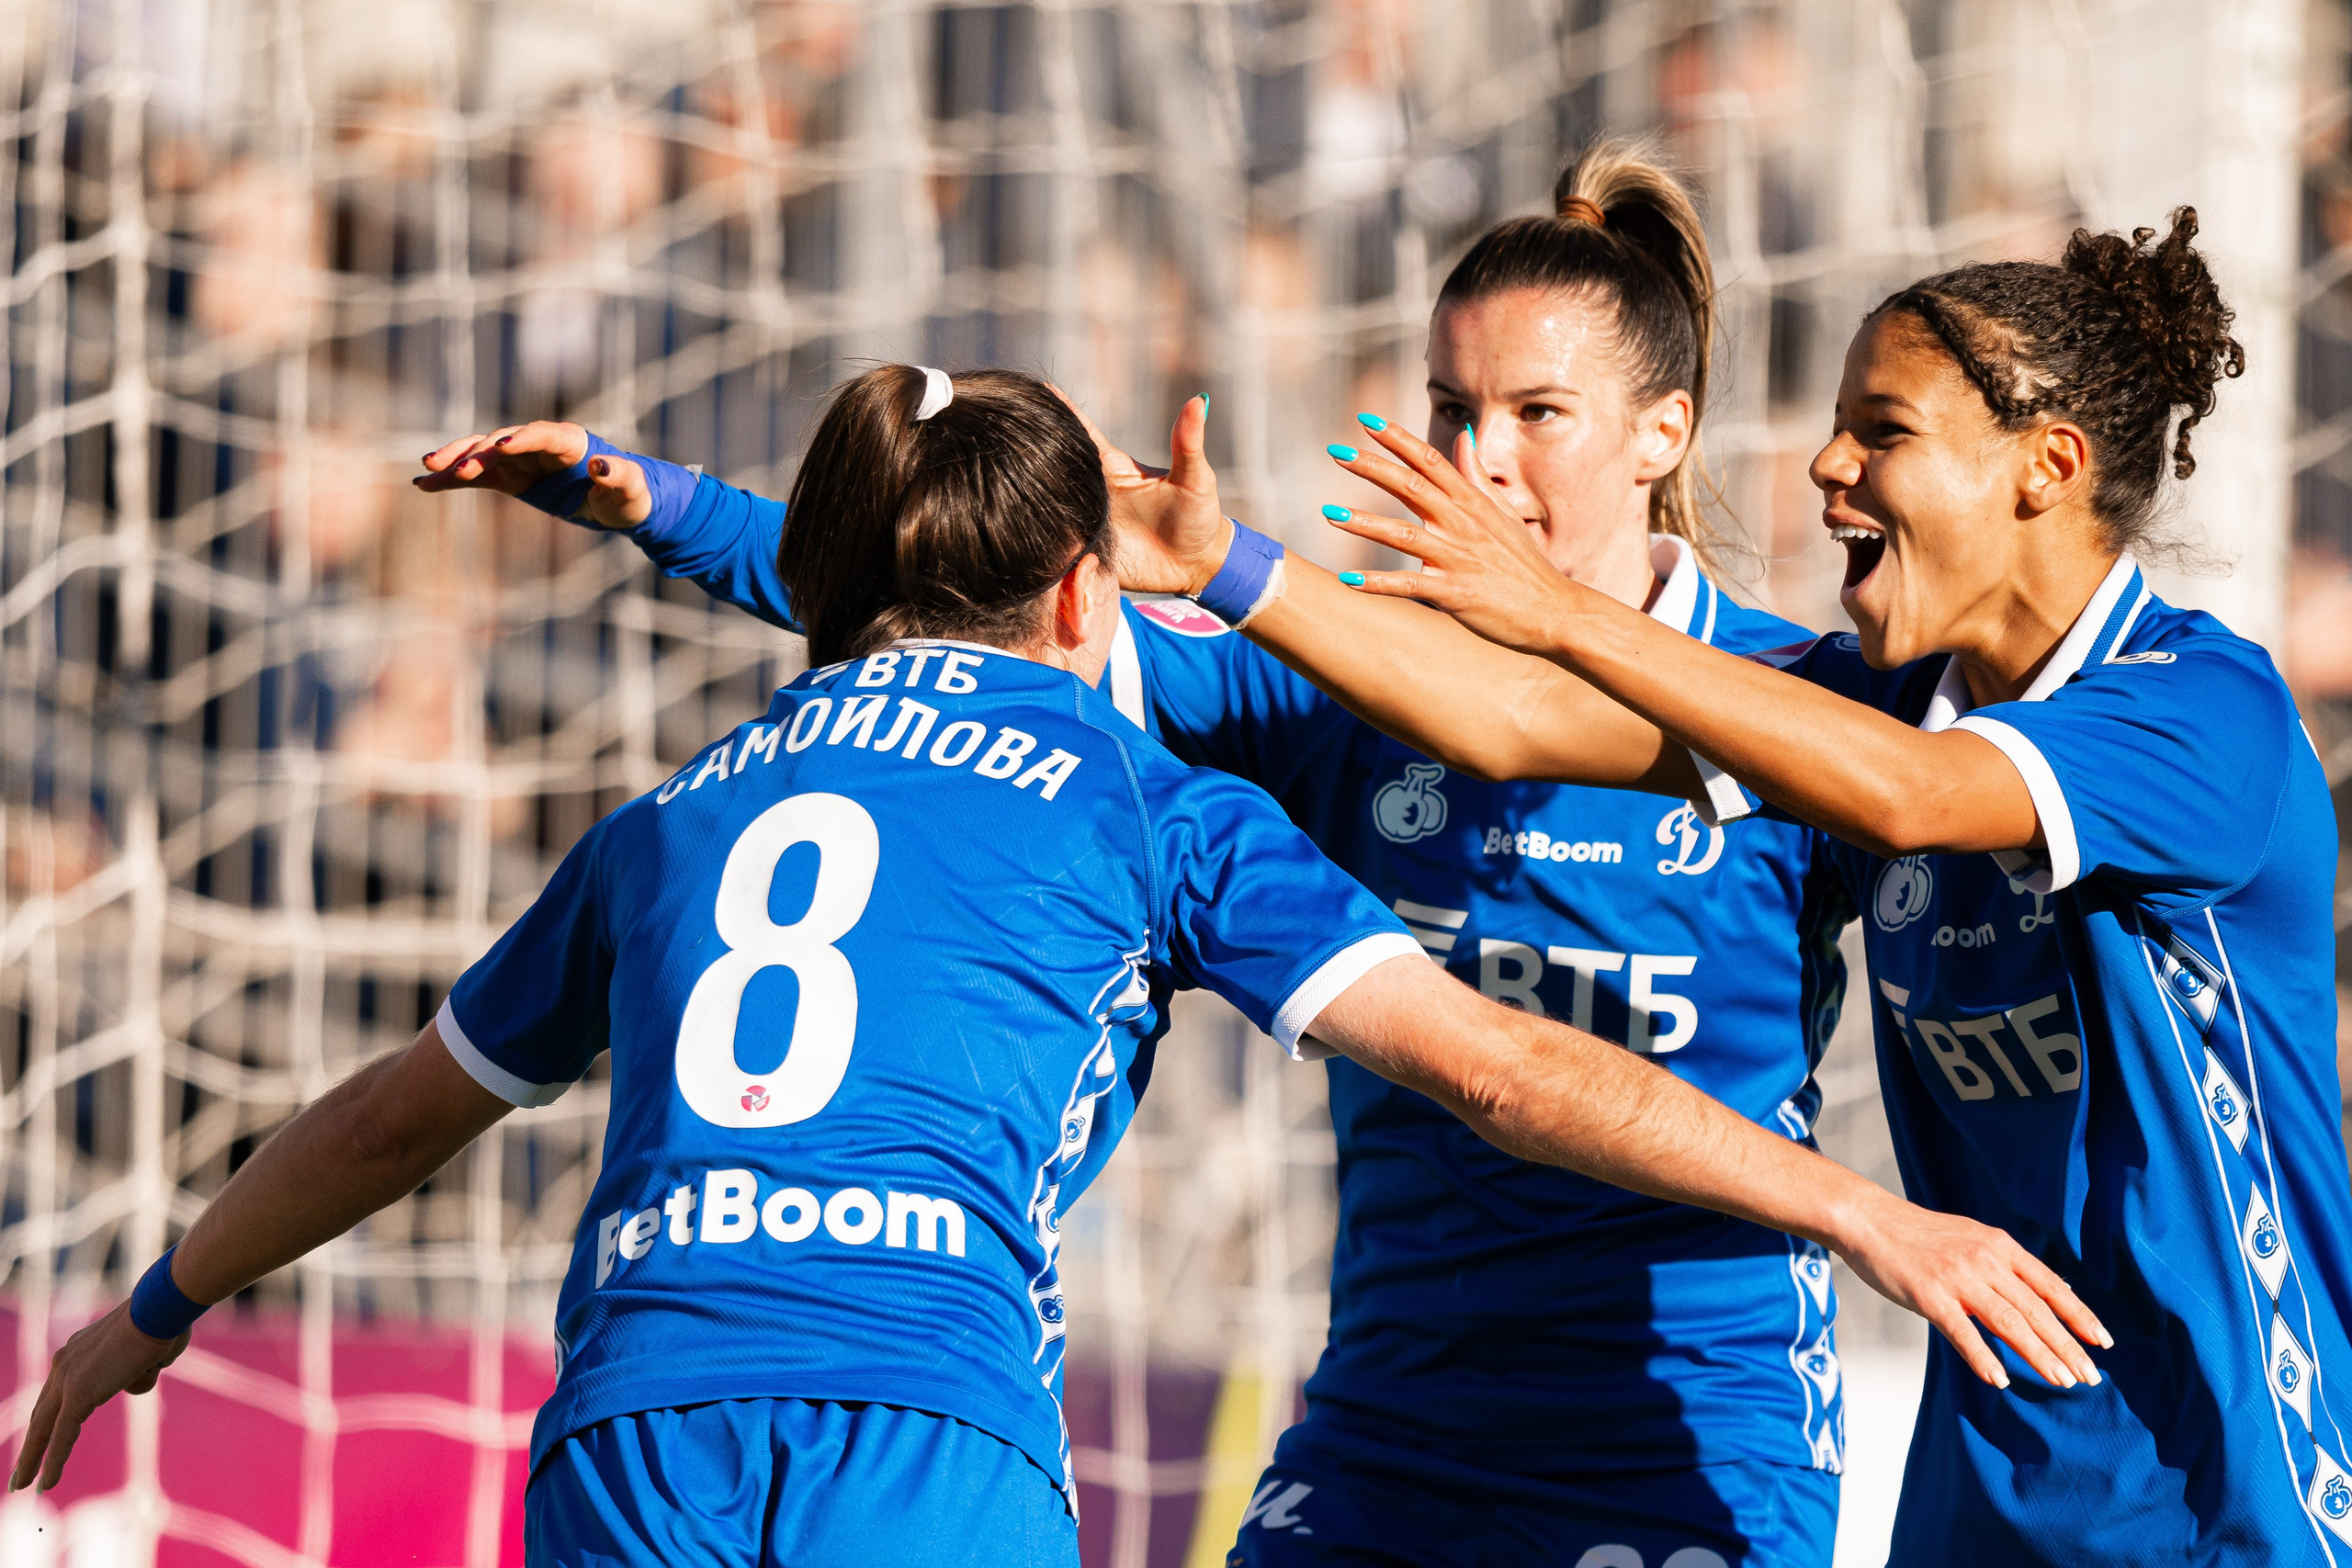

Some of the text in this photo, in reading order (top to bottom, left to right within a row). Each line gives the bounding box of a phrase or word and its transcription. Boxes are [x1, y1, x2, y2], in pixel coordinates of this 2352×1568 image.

[854, 649, 985, 694] ВТБ
[656, 694, 1082, 805] САМОЙЛОВА
[1483, 827, 1623, 863] BetBoom
[675, 792, 879, 1128] 8
[1480, 939, 1699, 1054] ВТБ
[1914, 994, 2083, 1101] ВТБ
[595, 1168, 967, 1290] BetBoom
